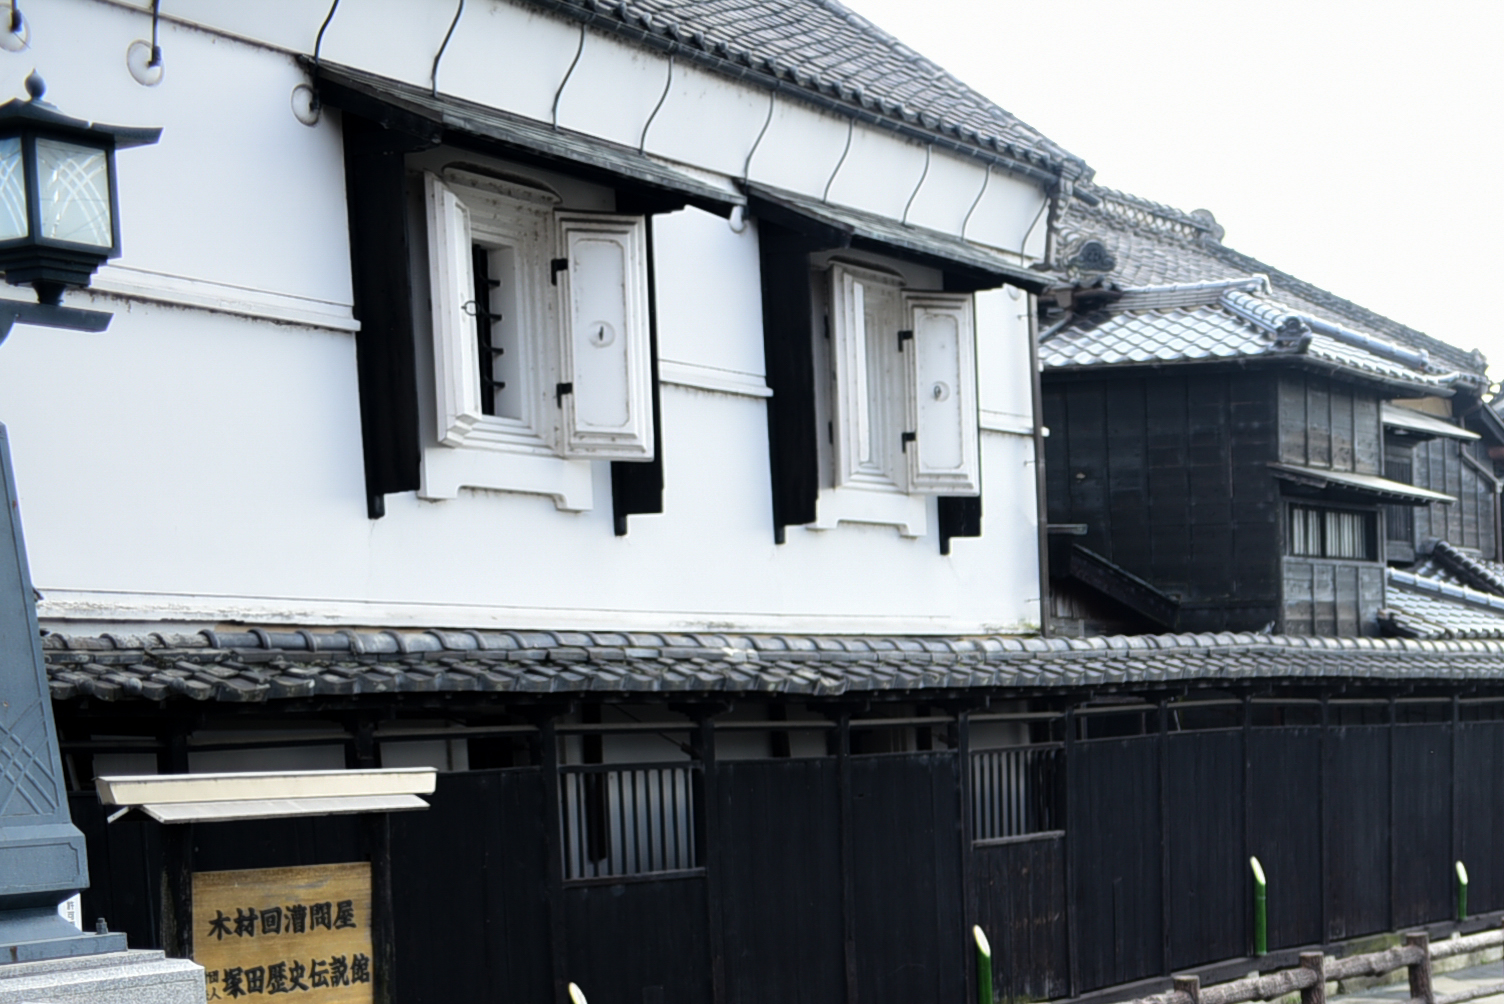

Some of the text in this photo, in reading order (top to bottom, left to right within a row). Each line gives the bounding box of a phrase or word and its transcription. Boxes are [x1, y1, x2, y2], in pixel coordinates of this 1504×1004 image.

[208, 900, 357, 941] 木材回漕問屋
[205, 970, 219, 984] 団
[222, 953, 370, 999] 塚田歴史伝説館
[206, 987, 222, 1001] 人
